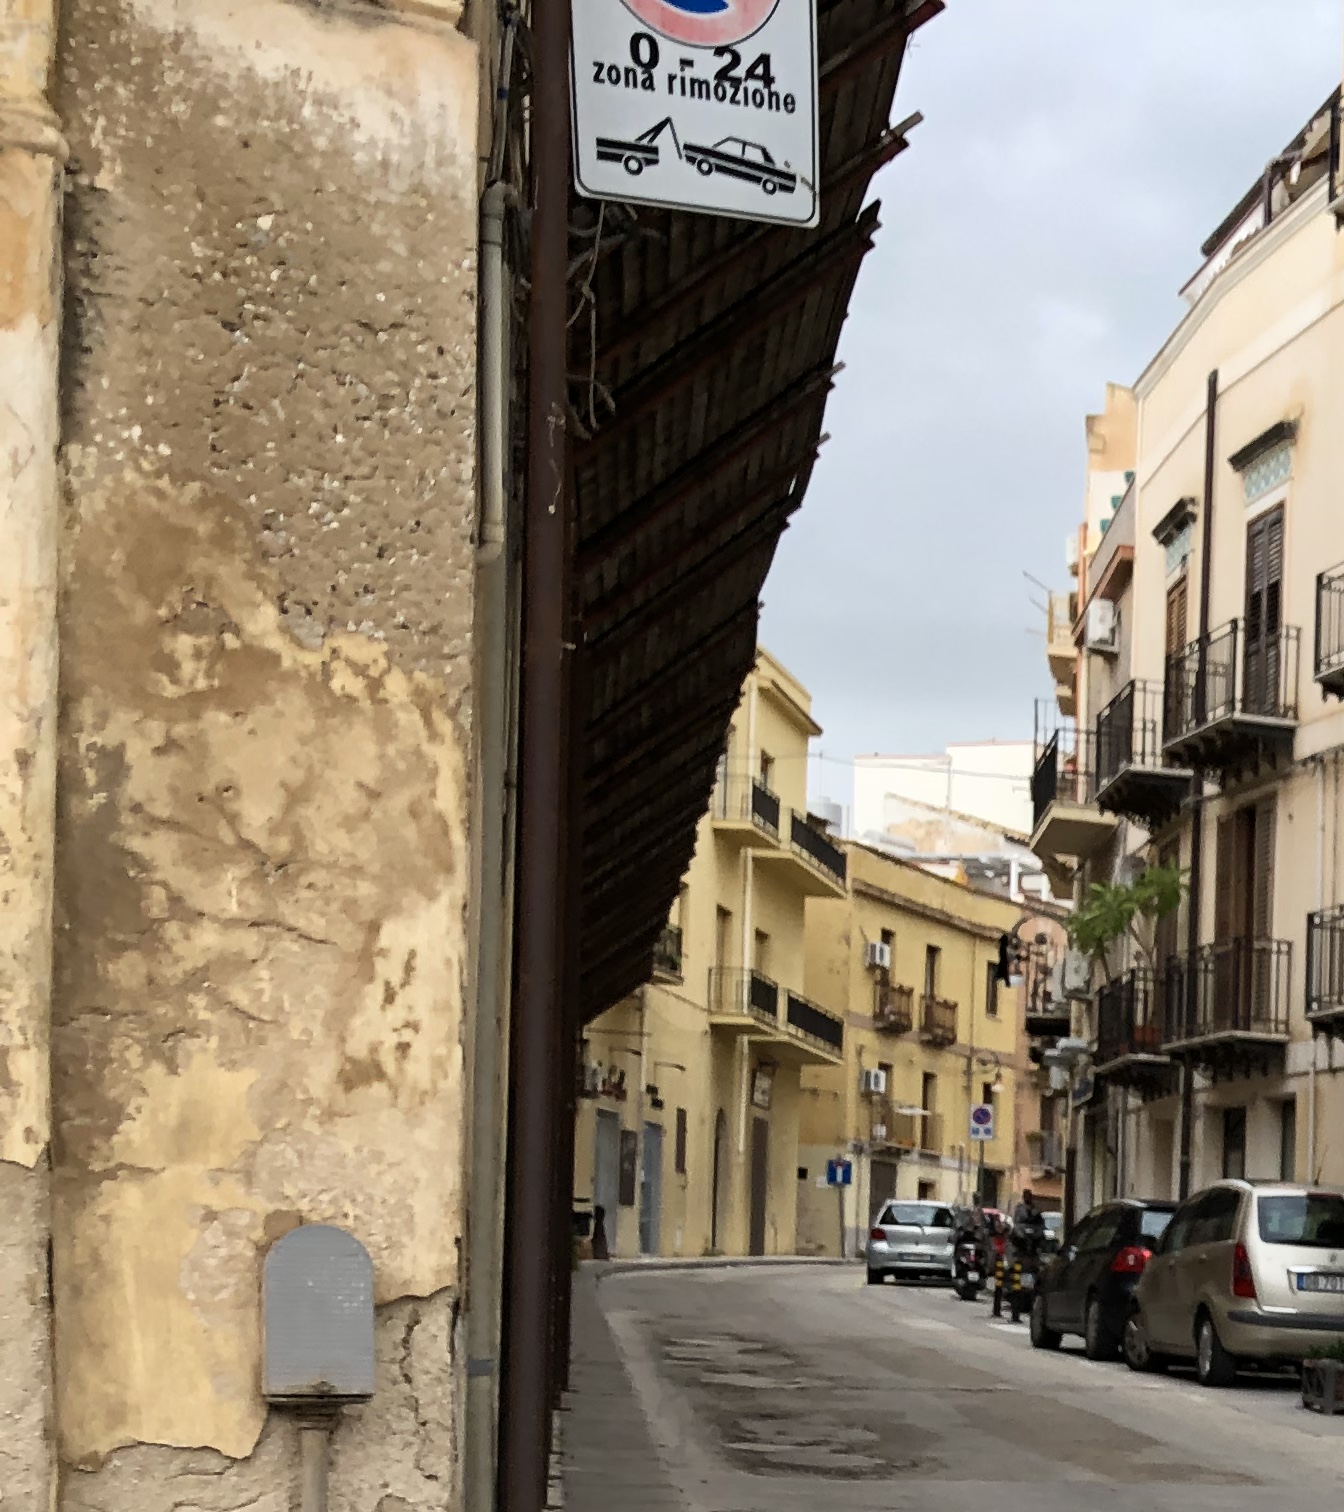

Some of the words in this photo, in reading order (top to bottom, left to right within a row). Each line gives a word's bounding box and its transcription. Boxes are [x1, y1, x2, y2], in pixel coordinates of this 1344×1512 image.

[592, 60, 656, 92] zona
[667, 70, 797, 114] rimozione
[629, 31, 660, 72] 0
[712, 46, 776, 90] 24
